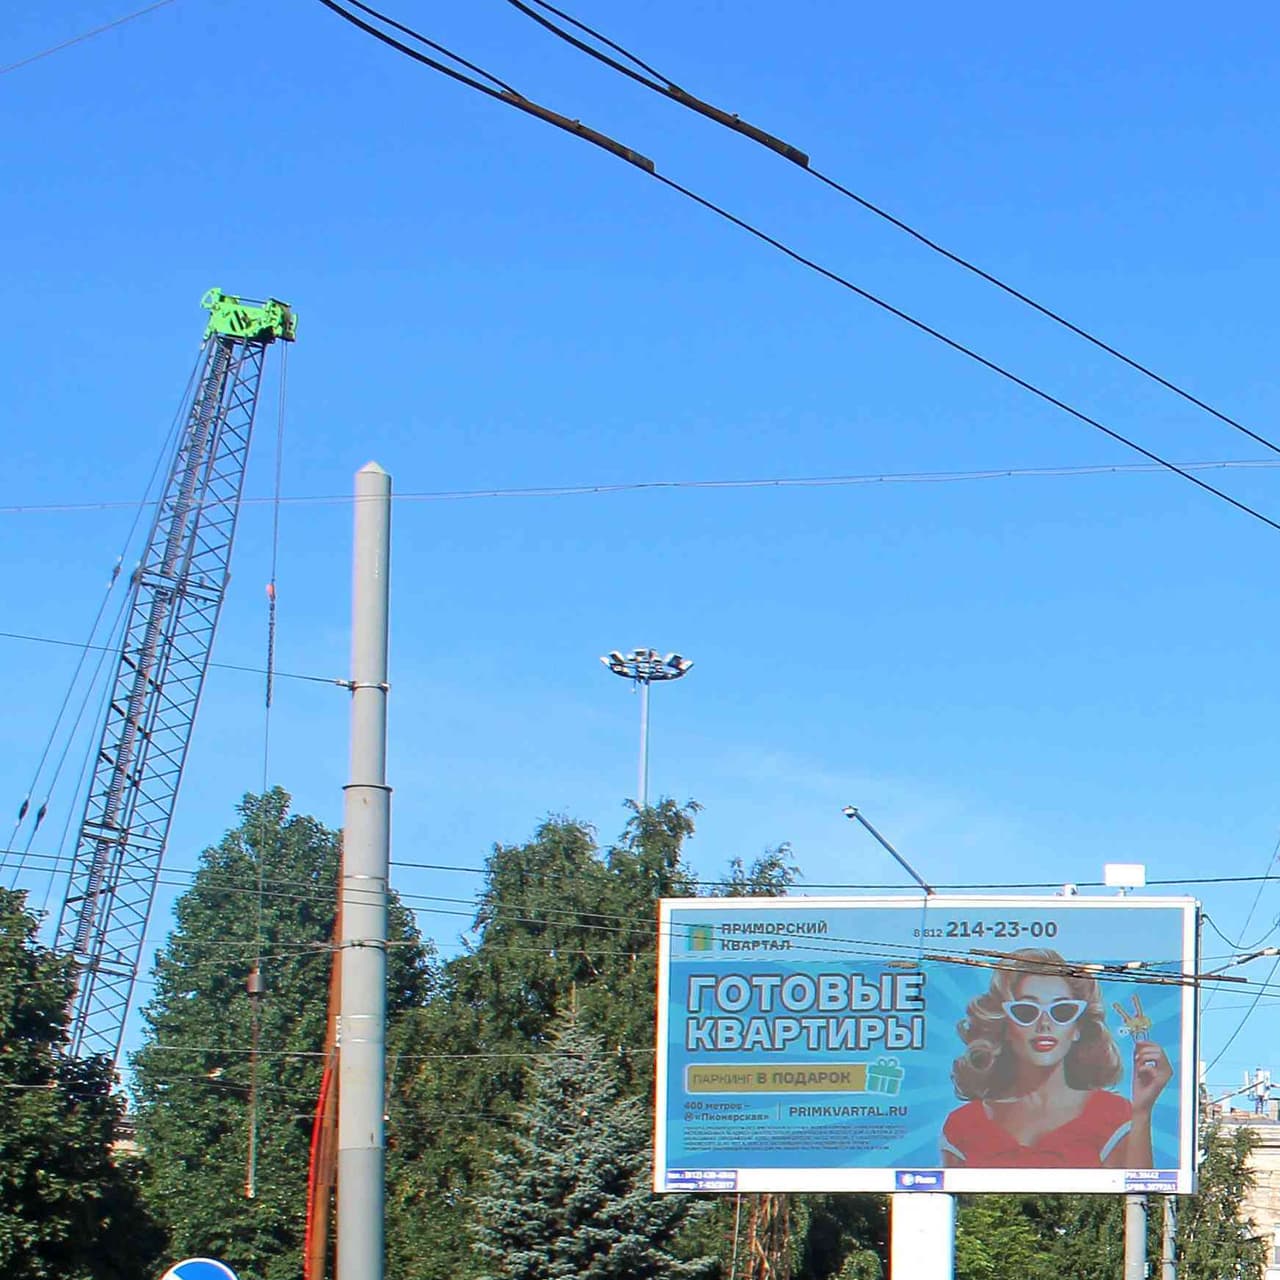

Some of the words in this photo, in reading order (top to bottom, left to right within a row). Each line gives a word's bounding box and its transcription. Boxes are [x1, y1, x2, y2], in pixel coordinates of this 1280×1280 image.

[721, 920, 828, 934] ПРИМОРСКИЙ
[913, 928, 921, 938] 8
[923, 928, 944, 938] 812
[946, 921, 1058, 938] 214-23-00
[721, 939, 793, 951] КВАРТАЛ
[687, 972, 925, 1013] ГОТОВЫЕ
[687, 1015, 925, 1051] КВАРТИРЫ
[693, 1073, 752, 1085] ПАРКИНГ
[756, 1072, 766, 1084] В
[772, 1071, 851, 1085] ПОДАРОК
[789, 1105, 908, 1117] PRIMKVARTAL.RU
